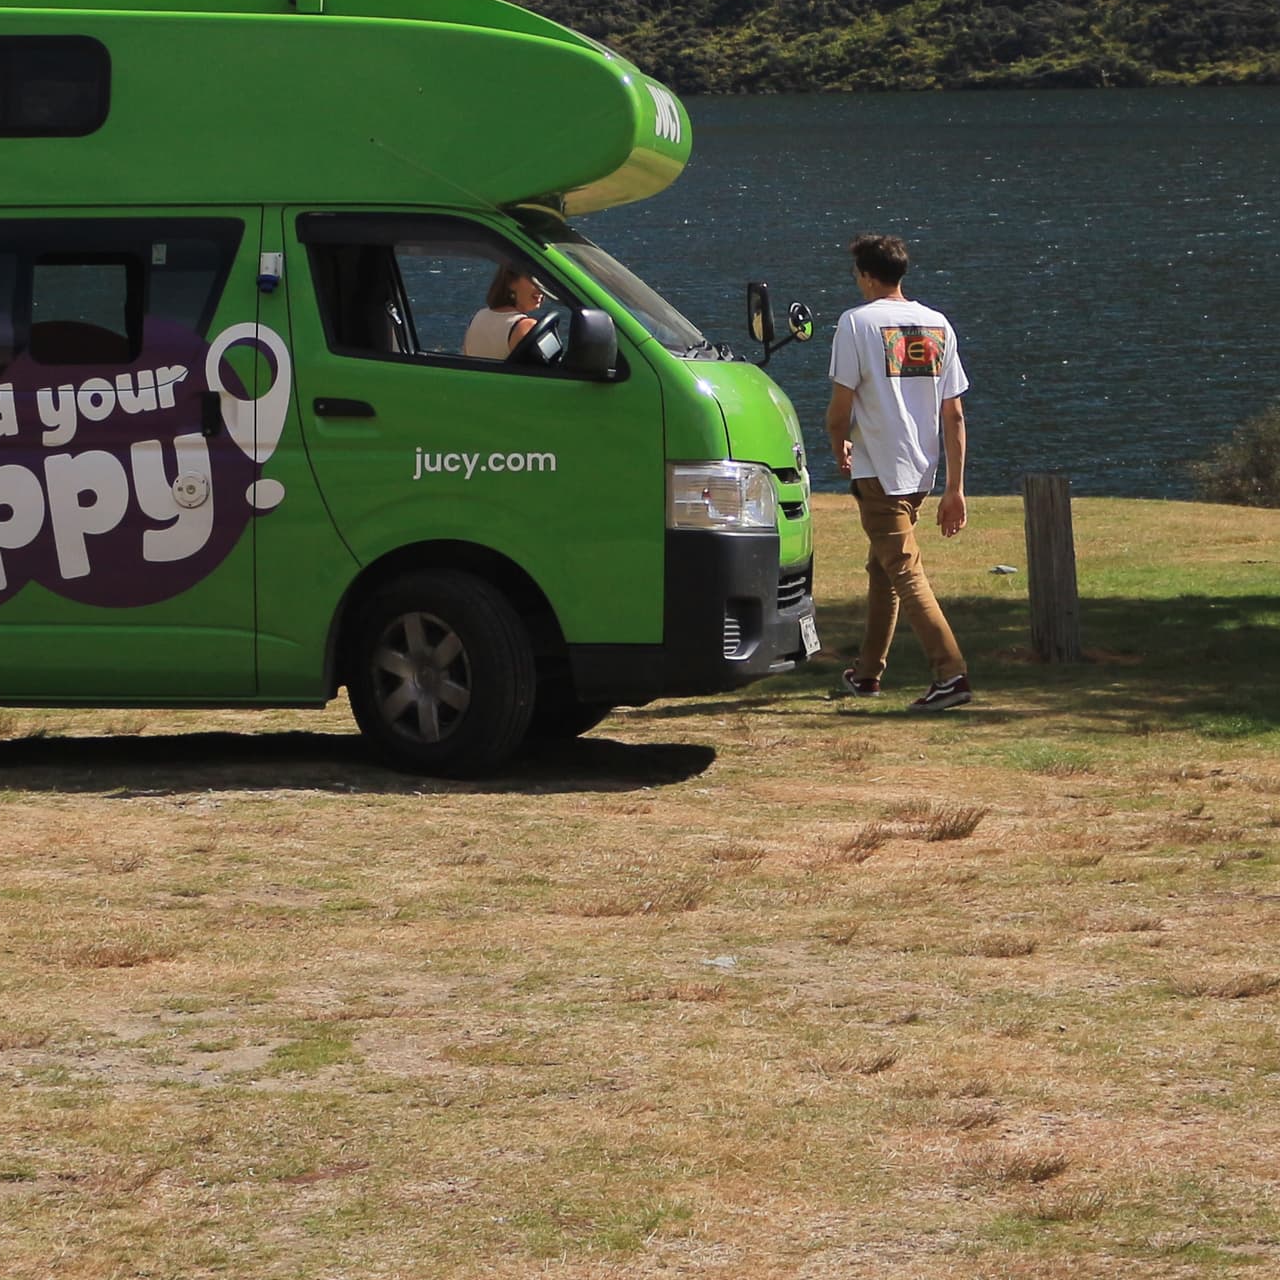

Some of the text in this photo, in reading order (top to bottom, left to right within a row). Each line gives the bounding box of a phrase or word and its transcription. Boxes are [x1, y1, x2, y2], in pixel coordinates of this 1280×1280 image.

[645, 82, 681, 144] JUCY
[37, 364, 189, 447] your
[413, 446, 557, 480] jucy.com
